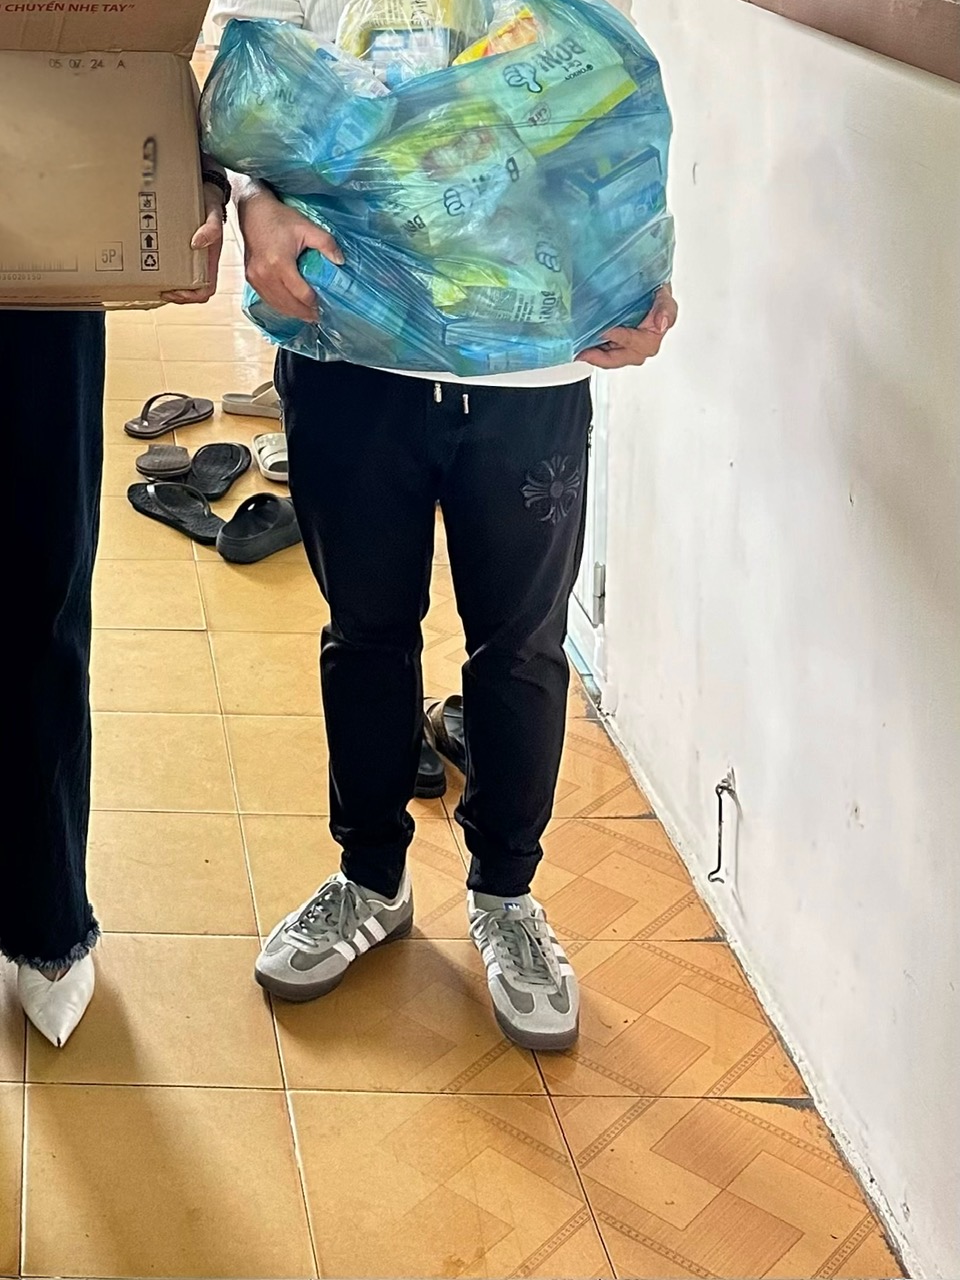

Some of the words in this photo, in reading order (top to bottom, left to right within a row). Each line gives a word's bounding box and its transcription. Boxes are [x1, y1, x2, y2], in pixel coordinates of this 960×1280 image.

[4, 0, 66, 13] CHUYỂN
[68, 3, 99, 15] NHẸ
[101, 248, 117, 264] 5P
